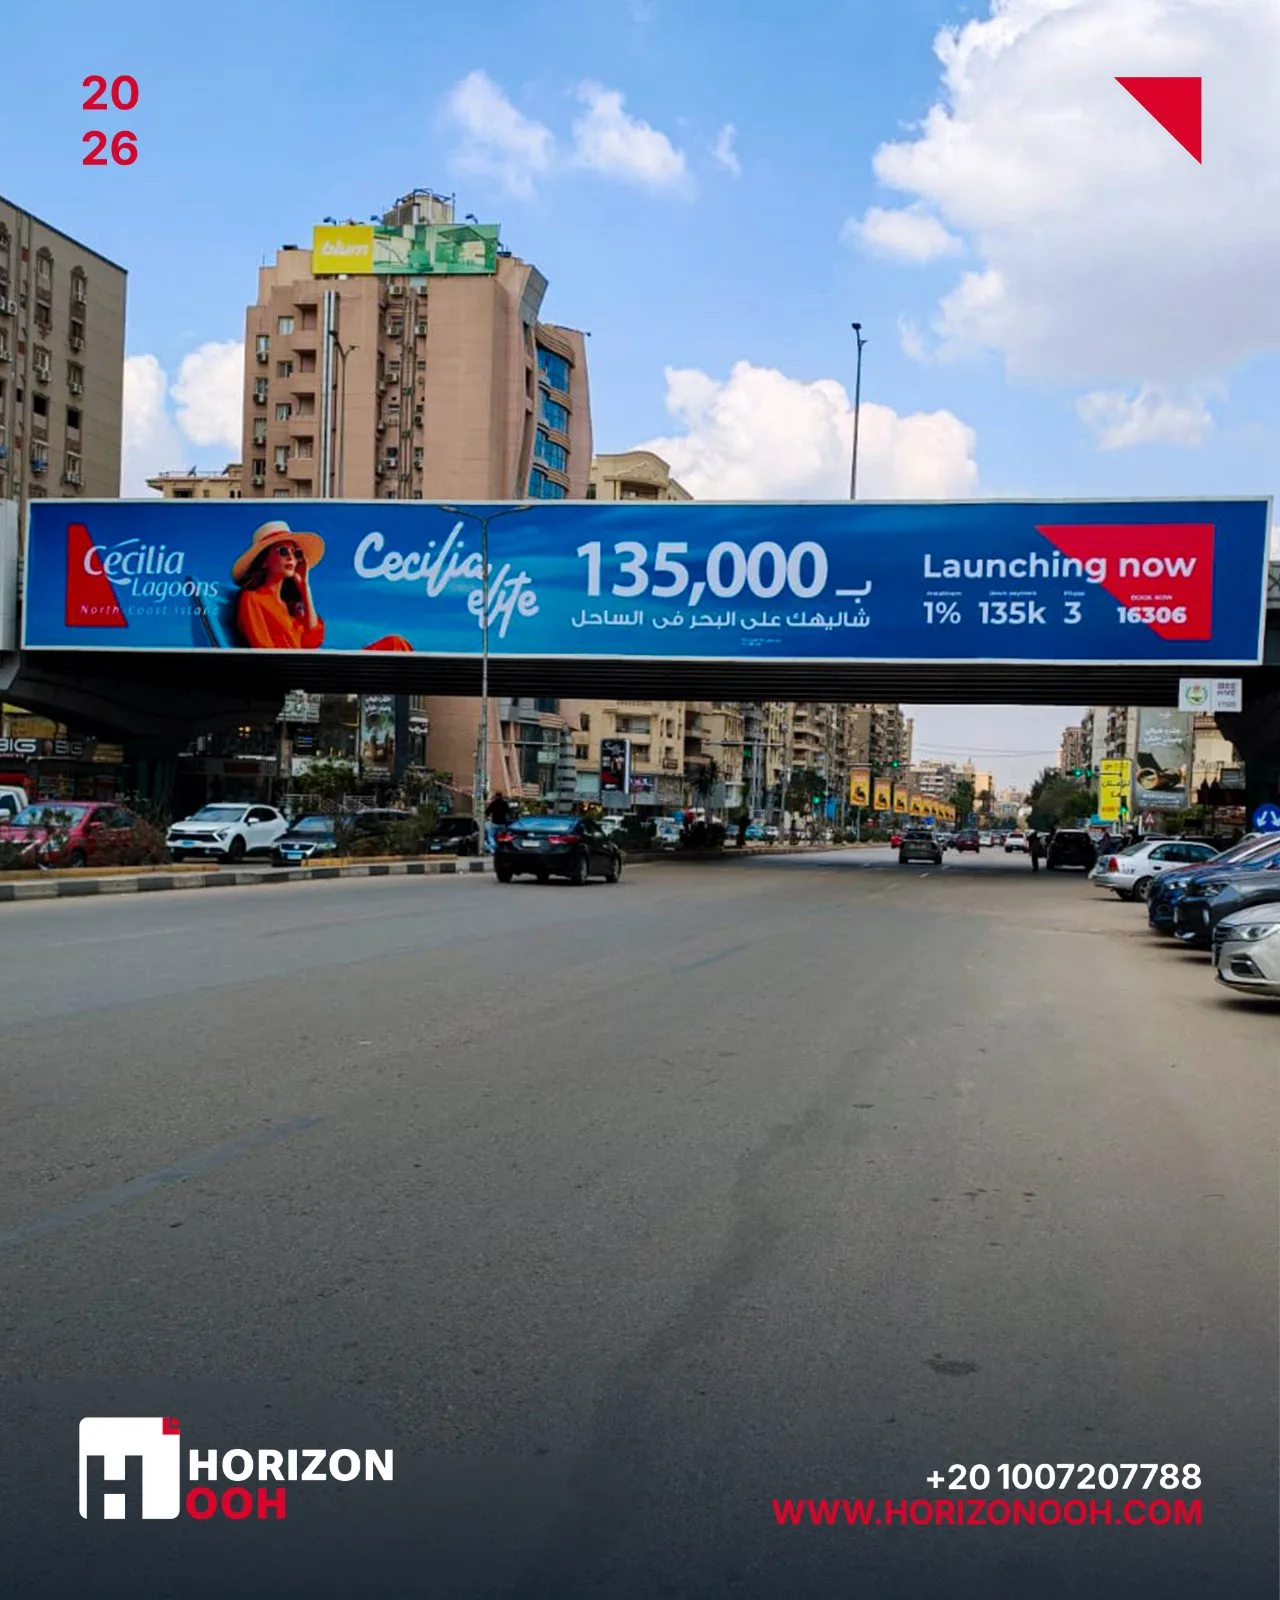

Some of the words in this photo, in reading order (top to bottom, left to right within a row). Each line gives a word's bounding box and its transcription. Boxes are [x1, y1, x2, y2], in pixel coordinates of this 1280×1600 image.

[354, 521, 492, 597] Cecilia
[923, 552, 1107, 583] Launching
[1119, 557, 1197, 578] now
[576, 541, 828, 606] 135,000
[132, 578, 219, 602] Lagoons
[467, 563, 540, 638] elite
[80, 604, 120, 615] North
[128, 604, 168, 615] Coast
[571, 609, 644, 628] الساحل
[689, 611, 736, 630] البحر
[786, 608, 871, 631] شاليهك
[923, 601, 962, 624] 1%
[978, 600, 1047, 625] 135k
[1063, 601, 1082, 624] 3
[1116, 605, 1188, 624] 16306
